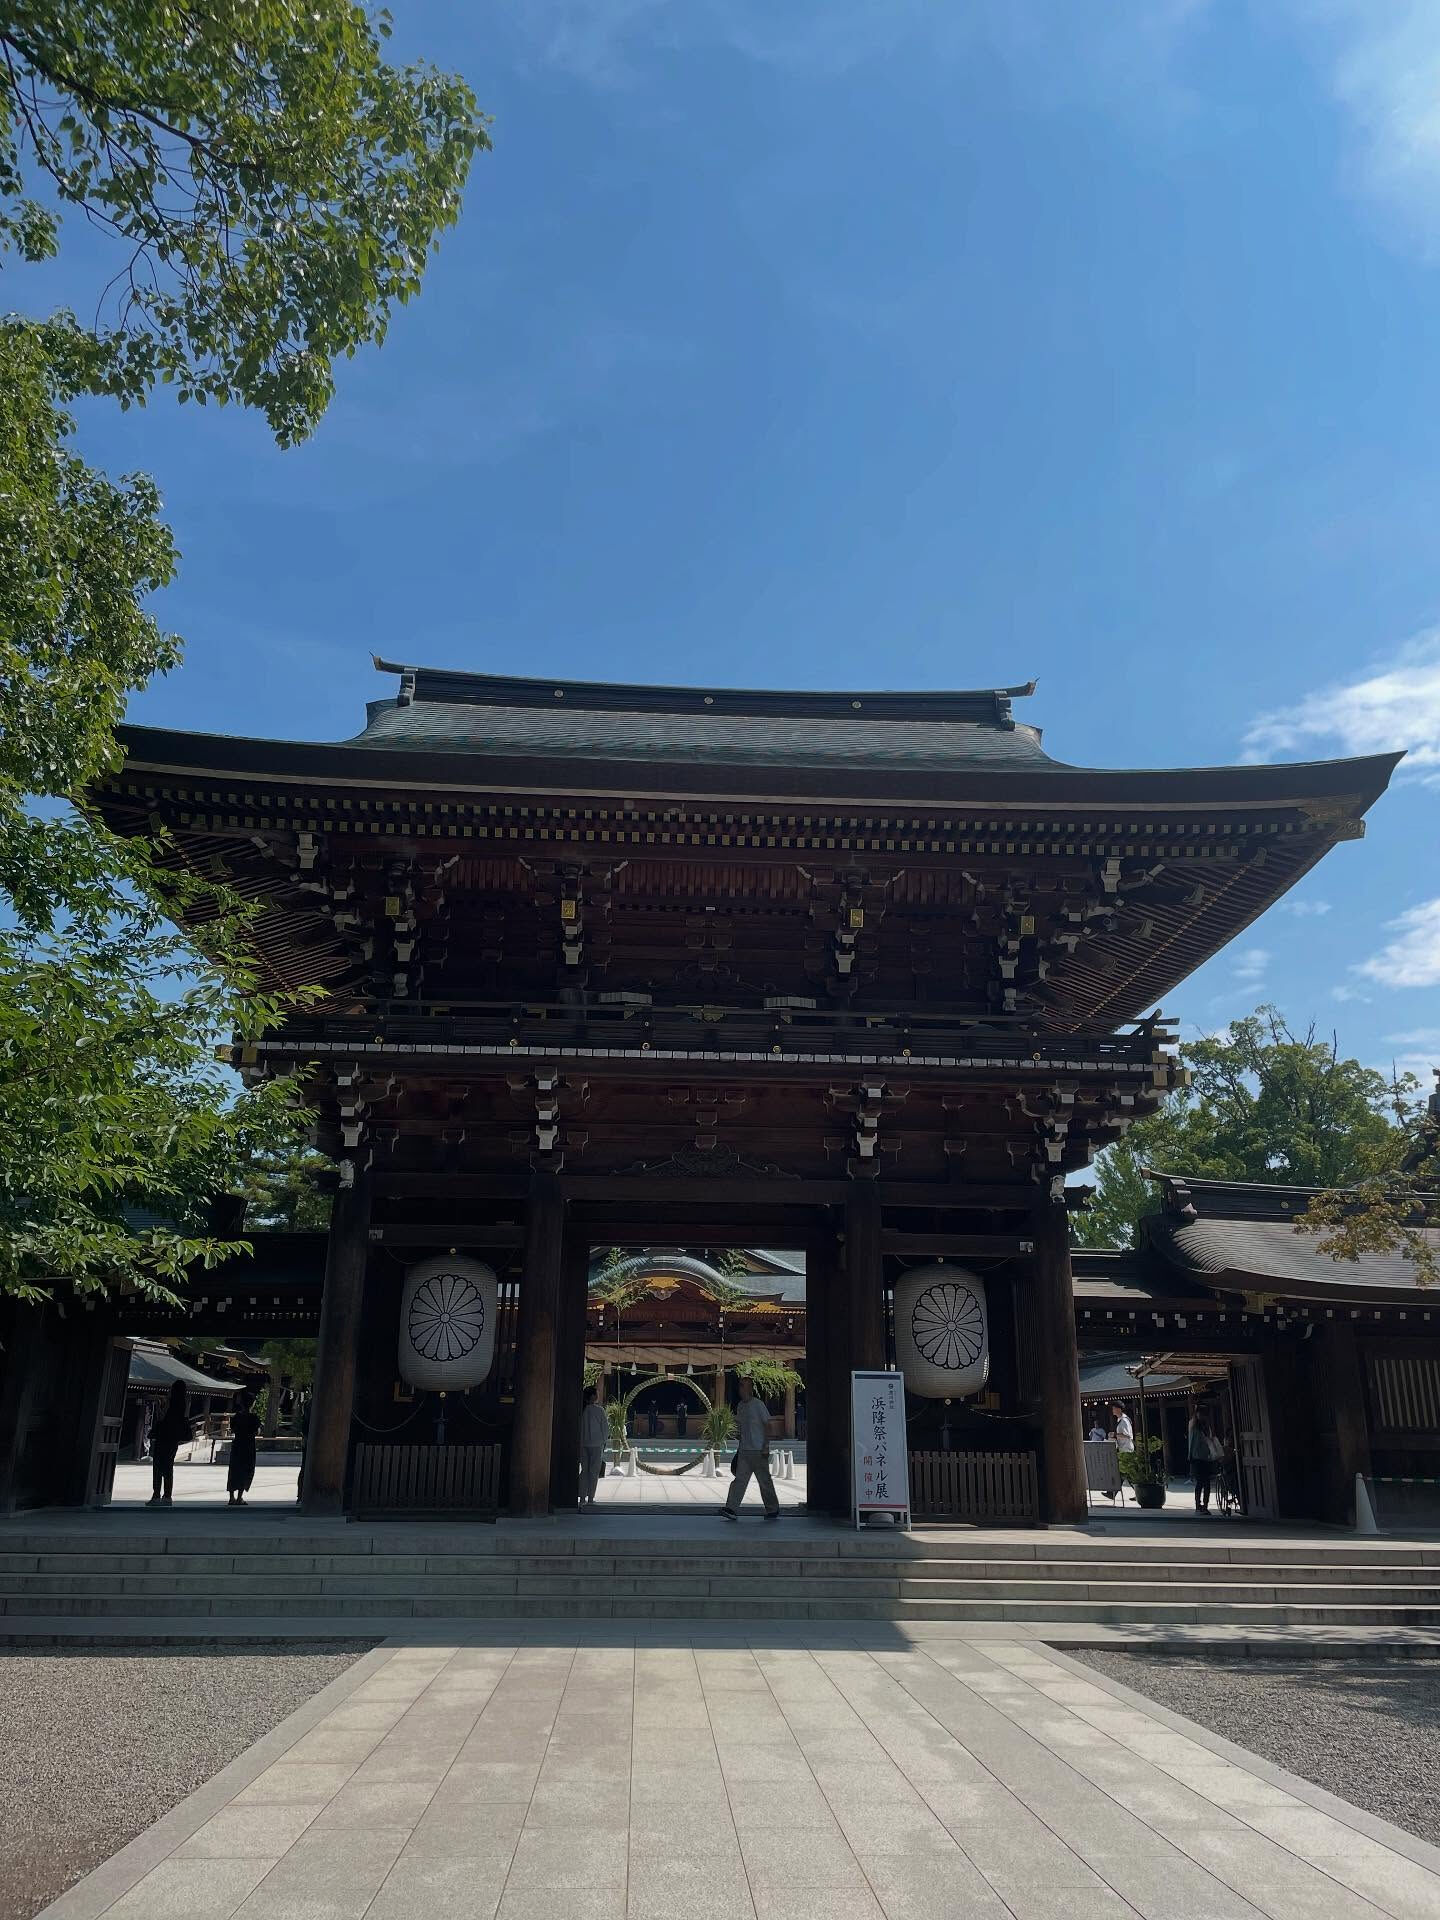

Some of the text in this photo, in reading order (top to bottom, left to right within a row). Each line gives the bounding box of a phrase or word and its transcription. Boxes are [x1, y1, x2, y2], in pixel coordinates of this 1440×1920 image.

[871, 1397, 889, 1499] 浜降祭パネル展
